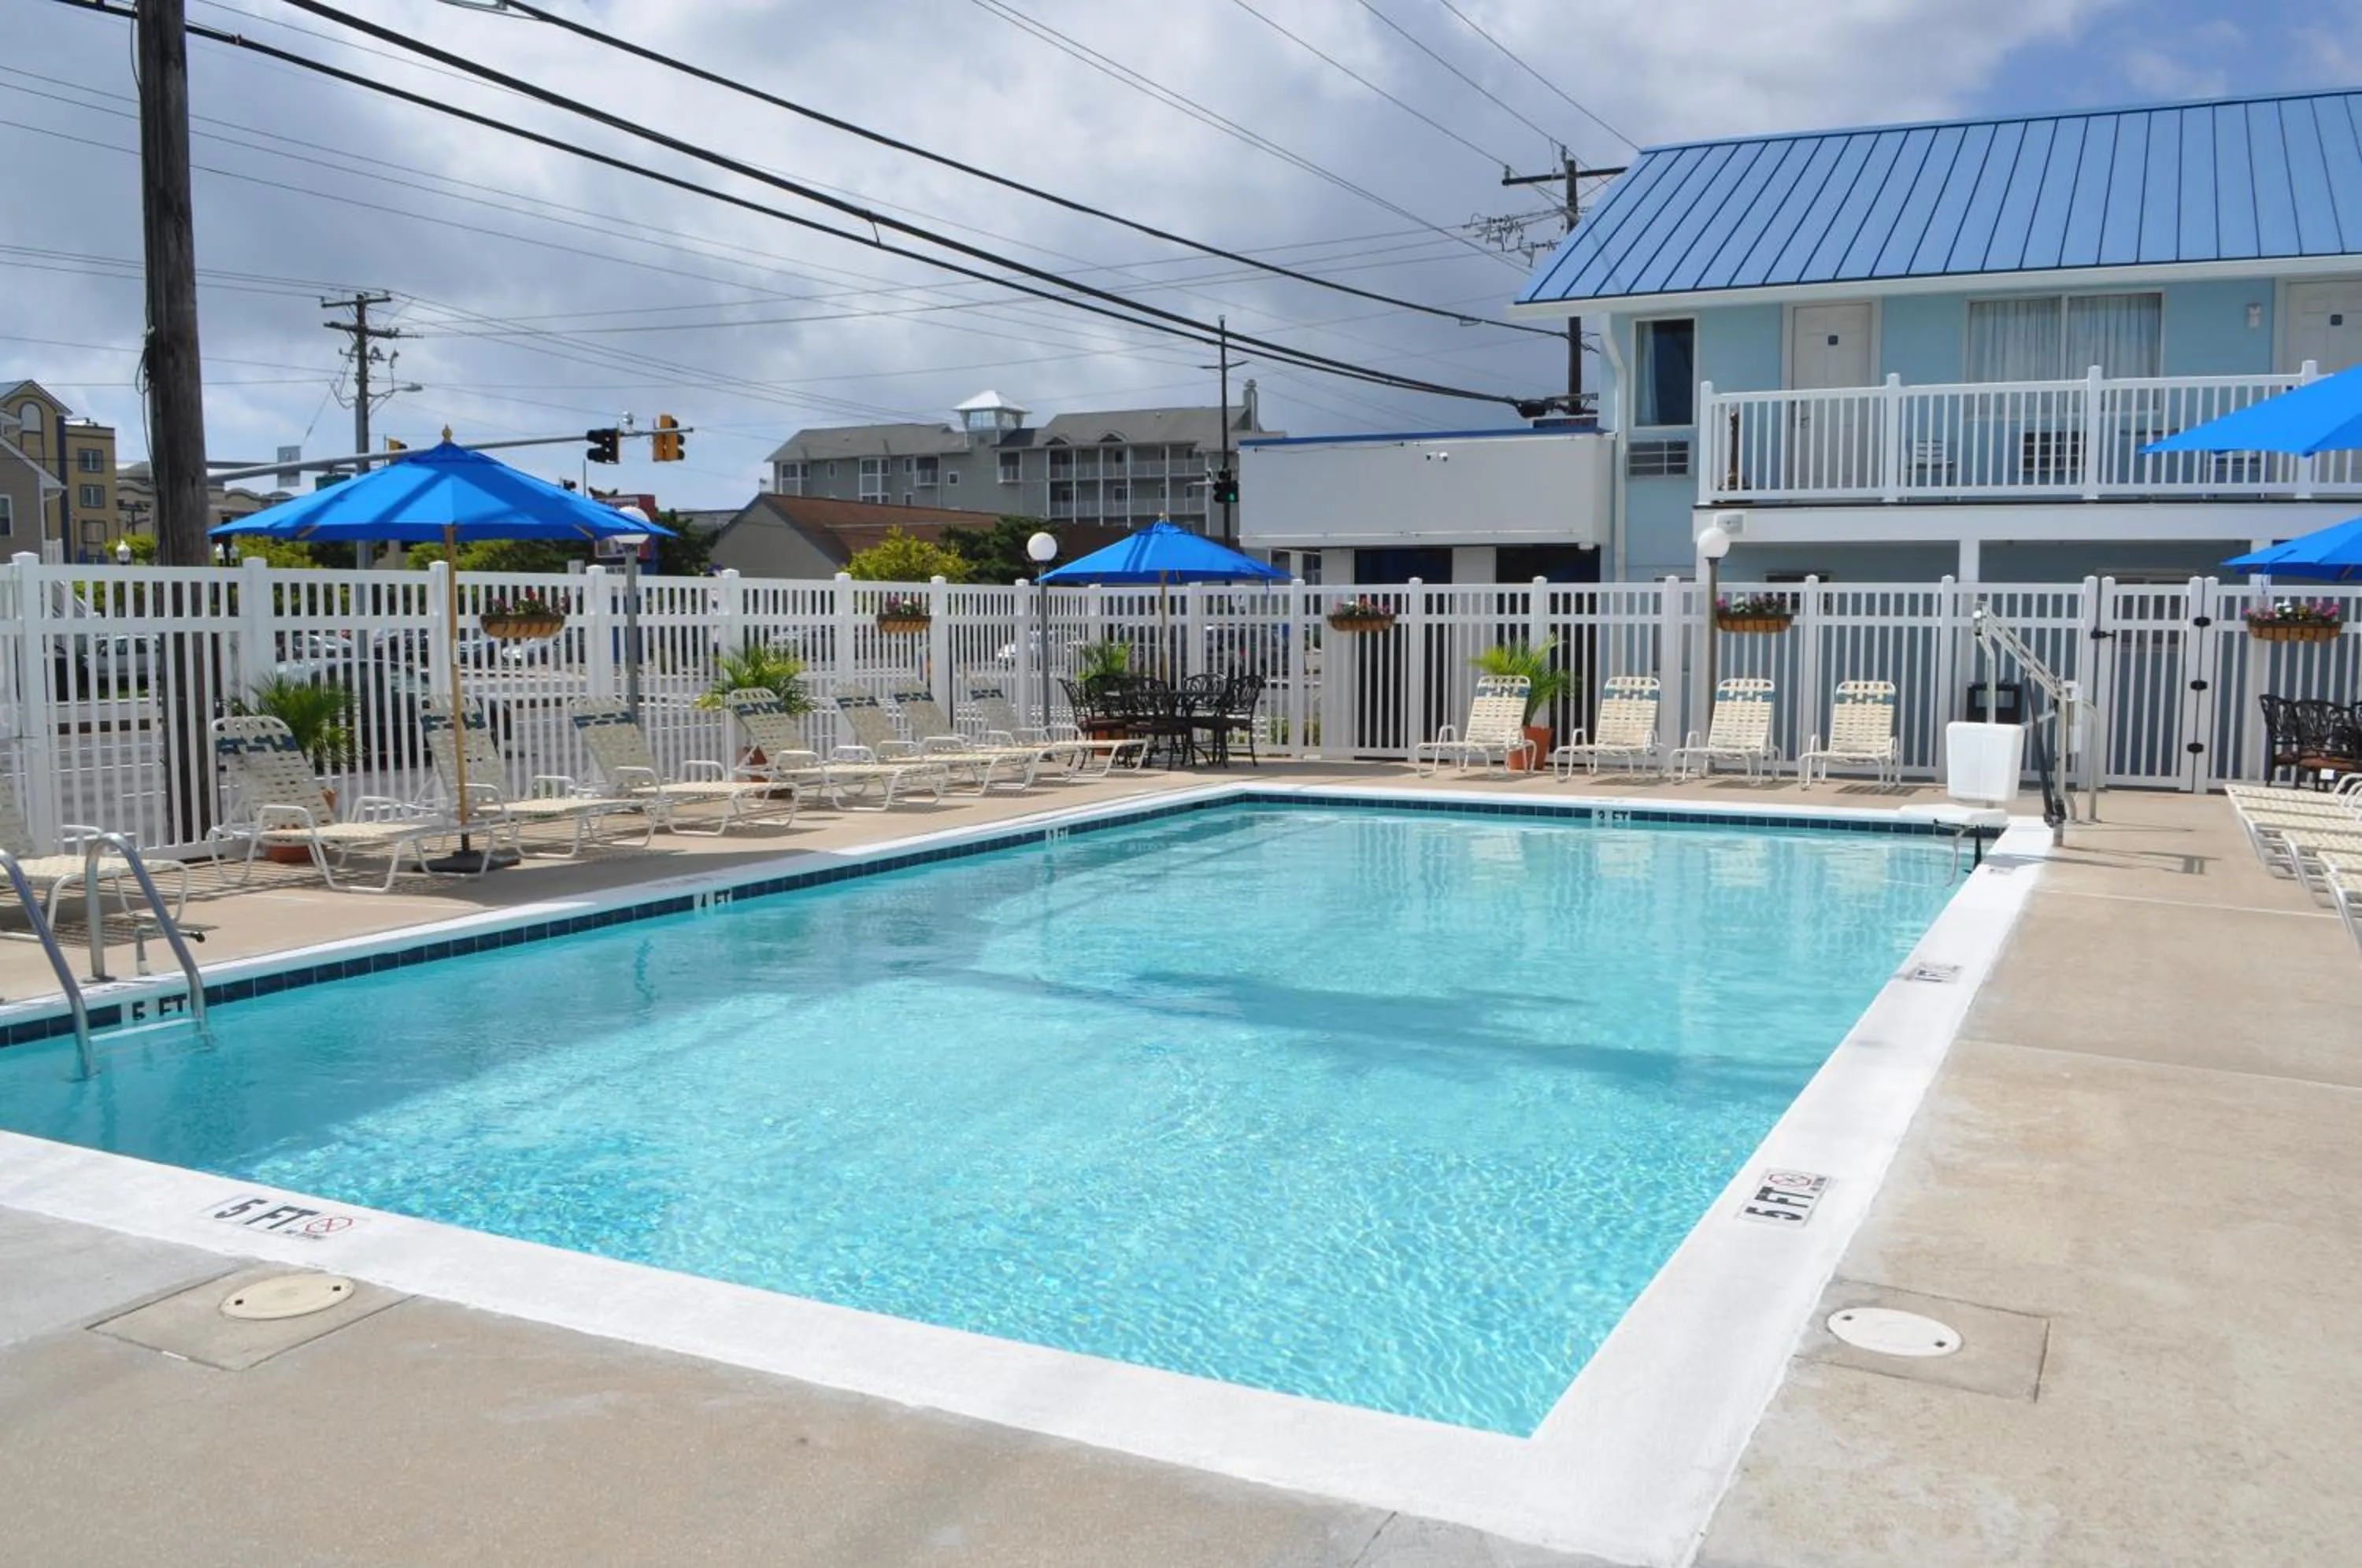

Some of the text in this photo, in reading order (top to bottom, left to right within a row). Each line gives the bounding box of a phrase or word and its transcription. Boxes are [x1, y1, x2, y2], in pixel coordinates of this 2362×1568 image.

[131, 993, 187, 1021] 5 FT
[213, 1198, 321, 1230] 5 FT
[1745, 1186, 1815, 1221] 5 FT
